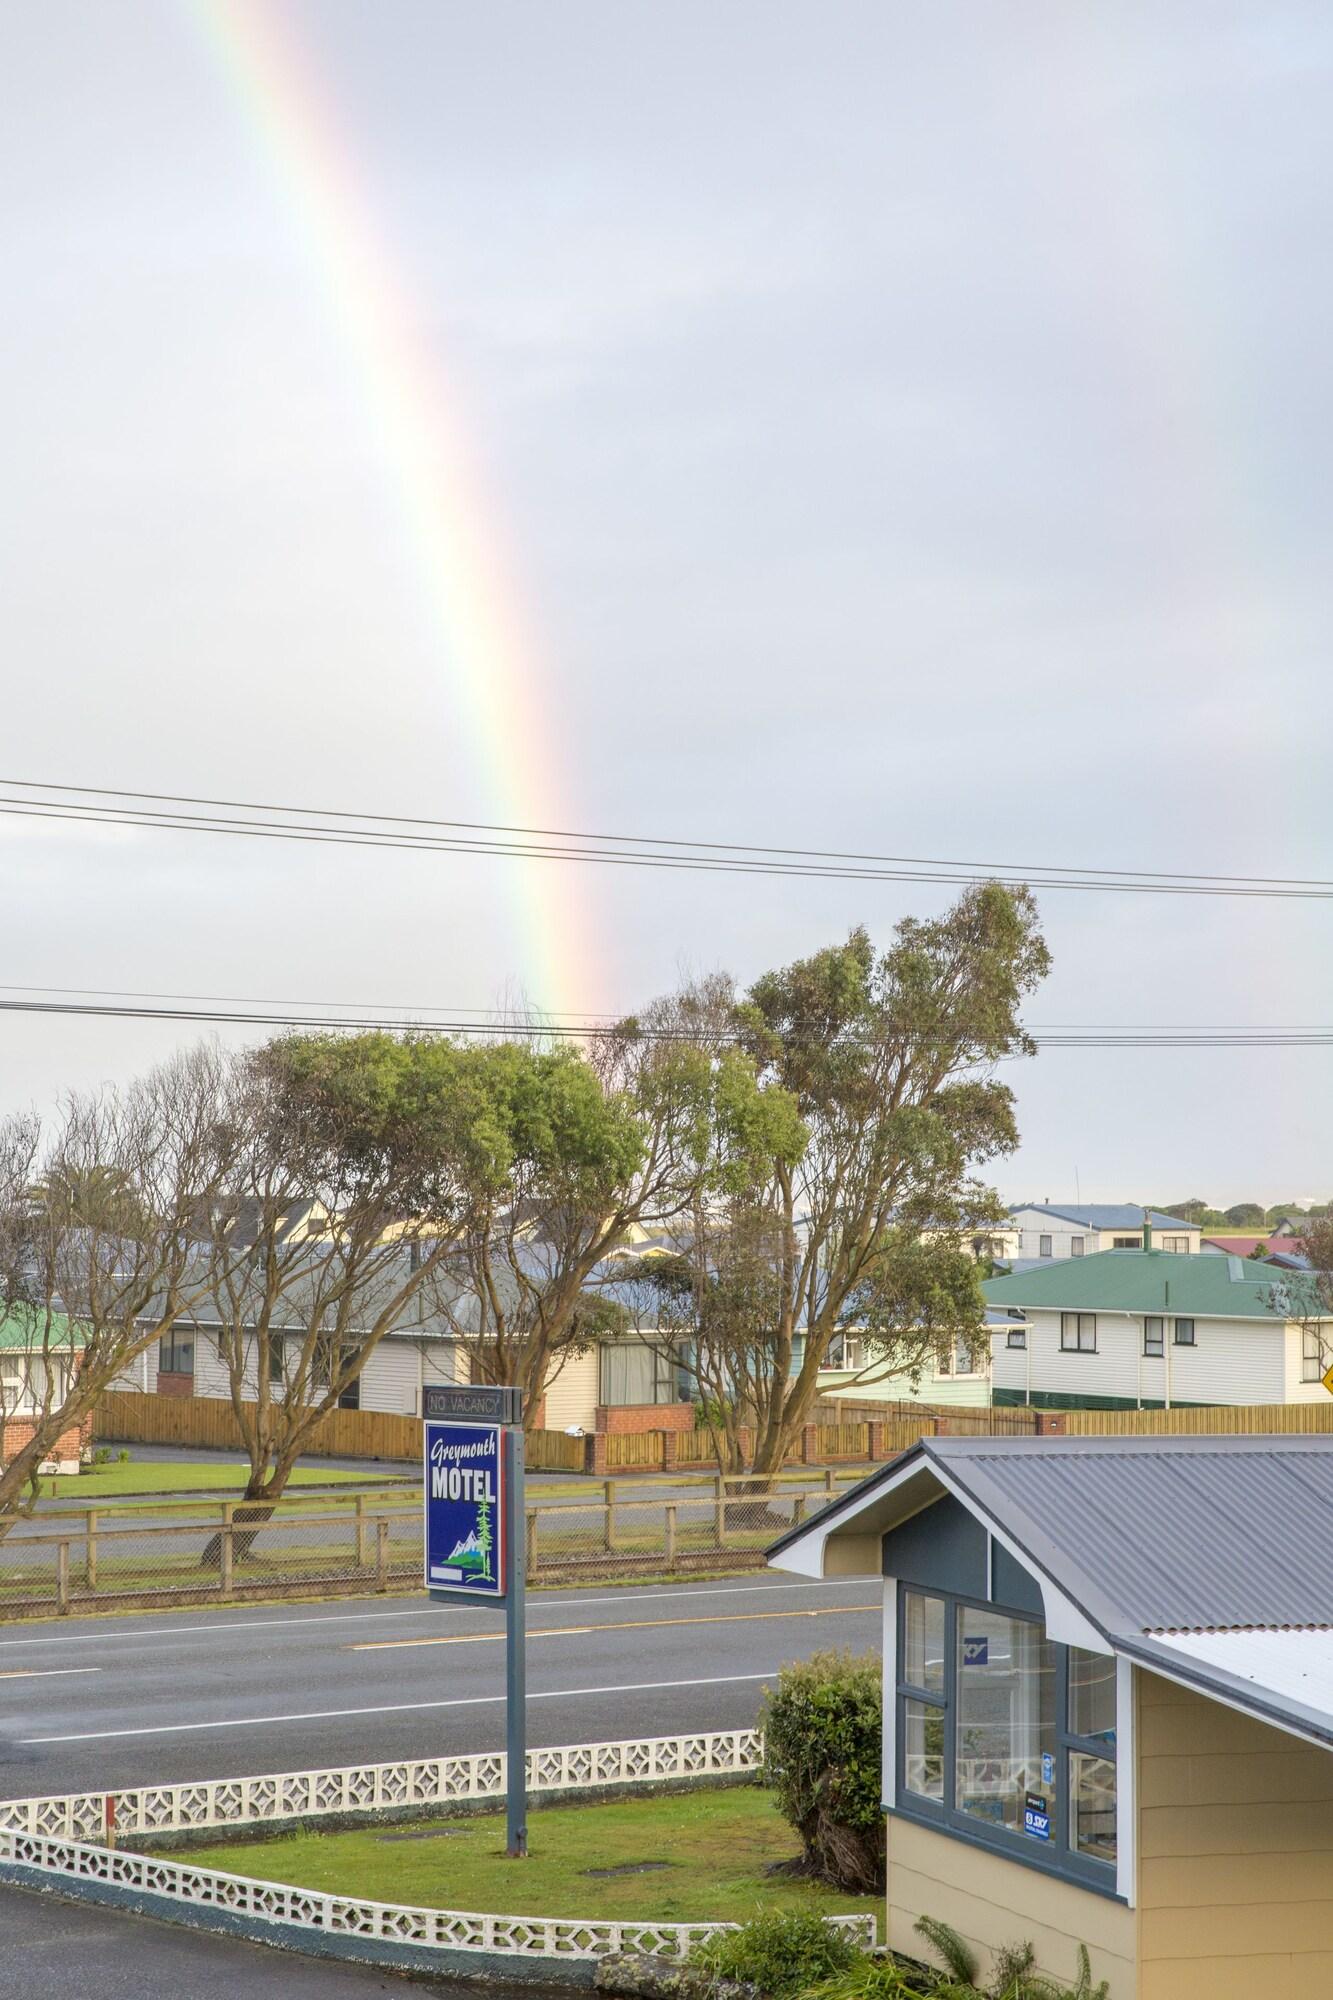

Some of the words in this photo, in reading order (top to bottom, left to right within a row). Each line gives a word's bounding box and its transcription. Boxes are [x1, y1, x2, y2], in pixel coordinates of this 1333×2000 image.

[430, 1395, 445, 1411] NO
[451, 1396, 500, 1414] VACANCY
[431, 1432, 495, 1467] Greymouth
[432, 1466, 496, 1503] MOTEL
